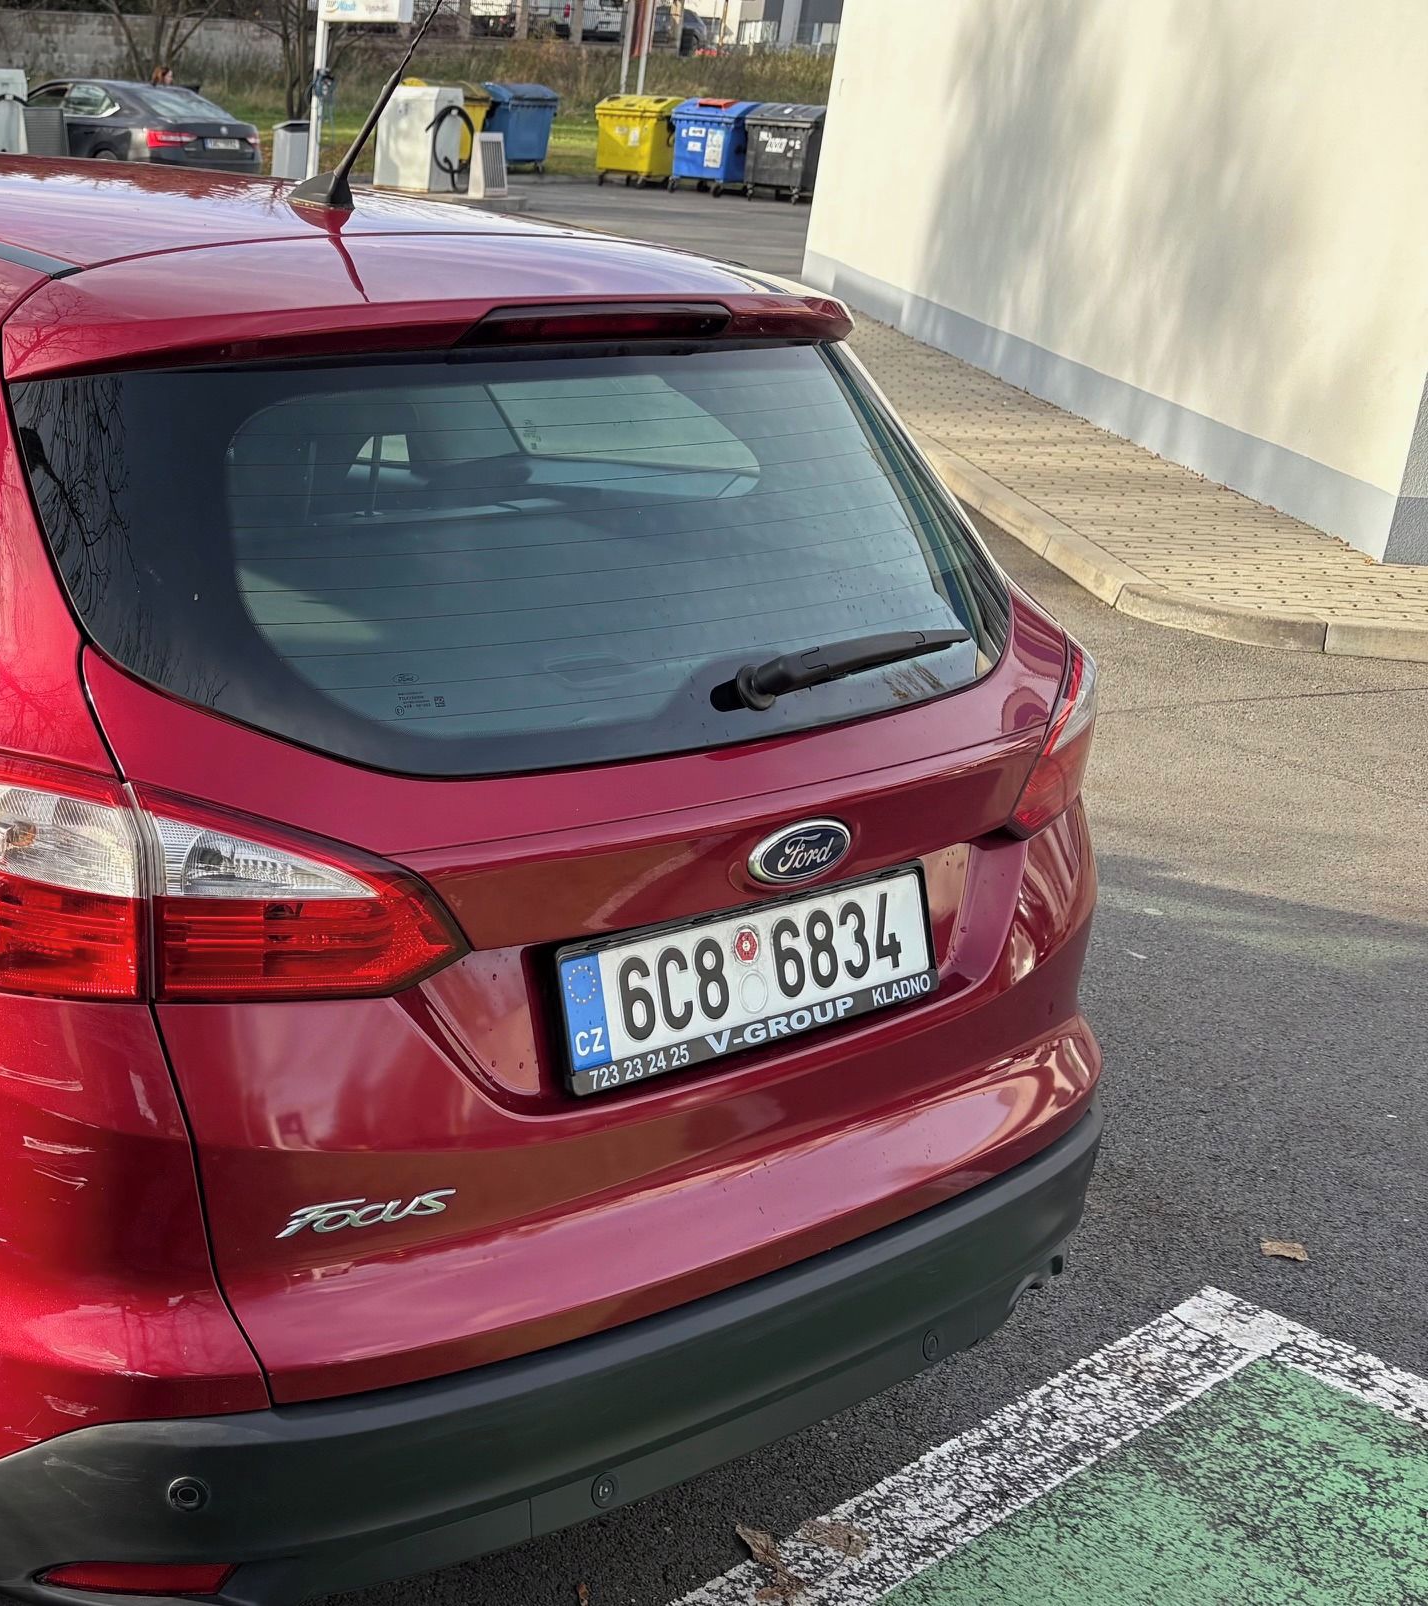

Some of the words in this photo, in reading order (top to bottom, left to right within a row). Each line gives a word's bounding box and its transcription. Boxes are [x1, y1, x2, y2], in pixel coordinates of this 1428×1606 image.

[776, 832, 833, 873] Ford
[619, 938, 730, 1041] 6C8
[772, 892, 902, 998] 6834
[872, 974, 931, 1007] KLADNO
[575, 1027, 605, 1057] CZ
[705, 997, 854, 1054] V-GROUP
[589, 1069, 620, 1090] 723
[623, 1059, 643, 1080] 23
[646, 1051, 667, 1073] 24
[669, 1044, 690, 1066] 25
